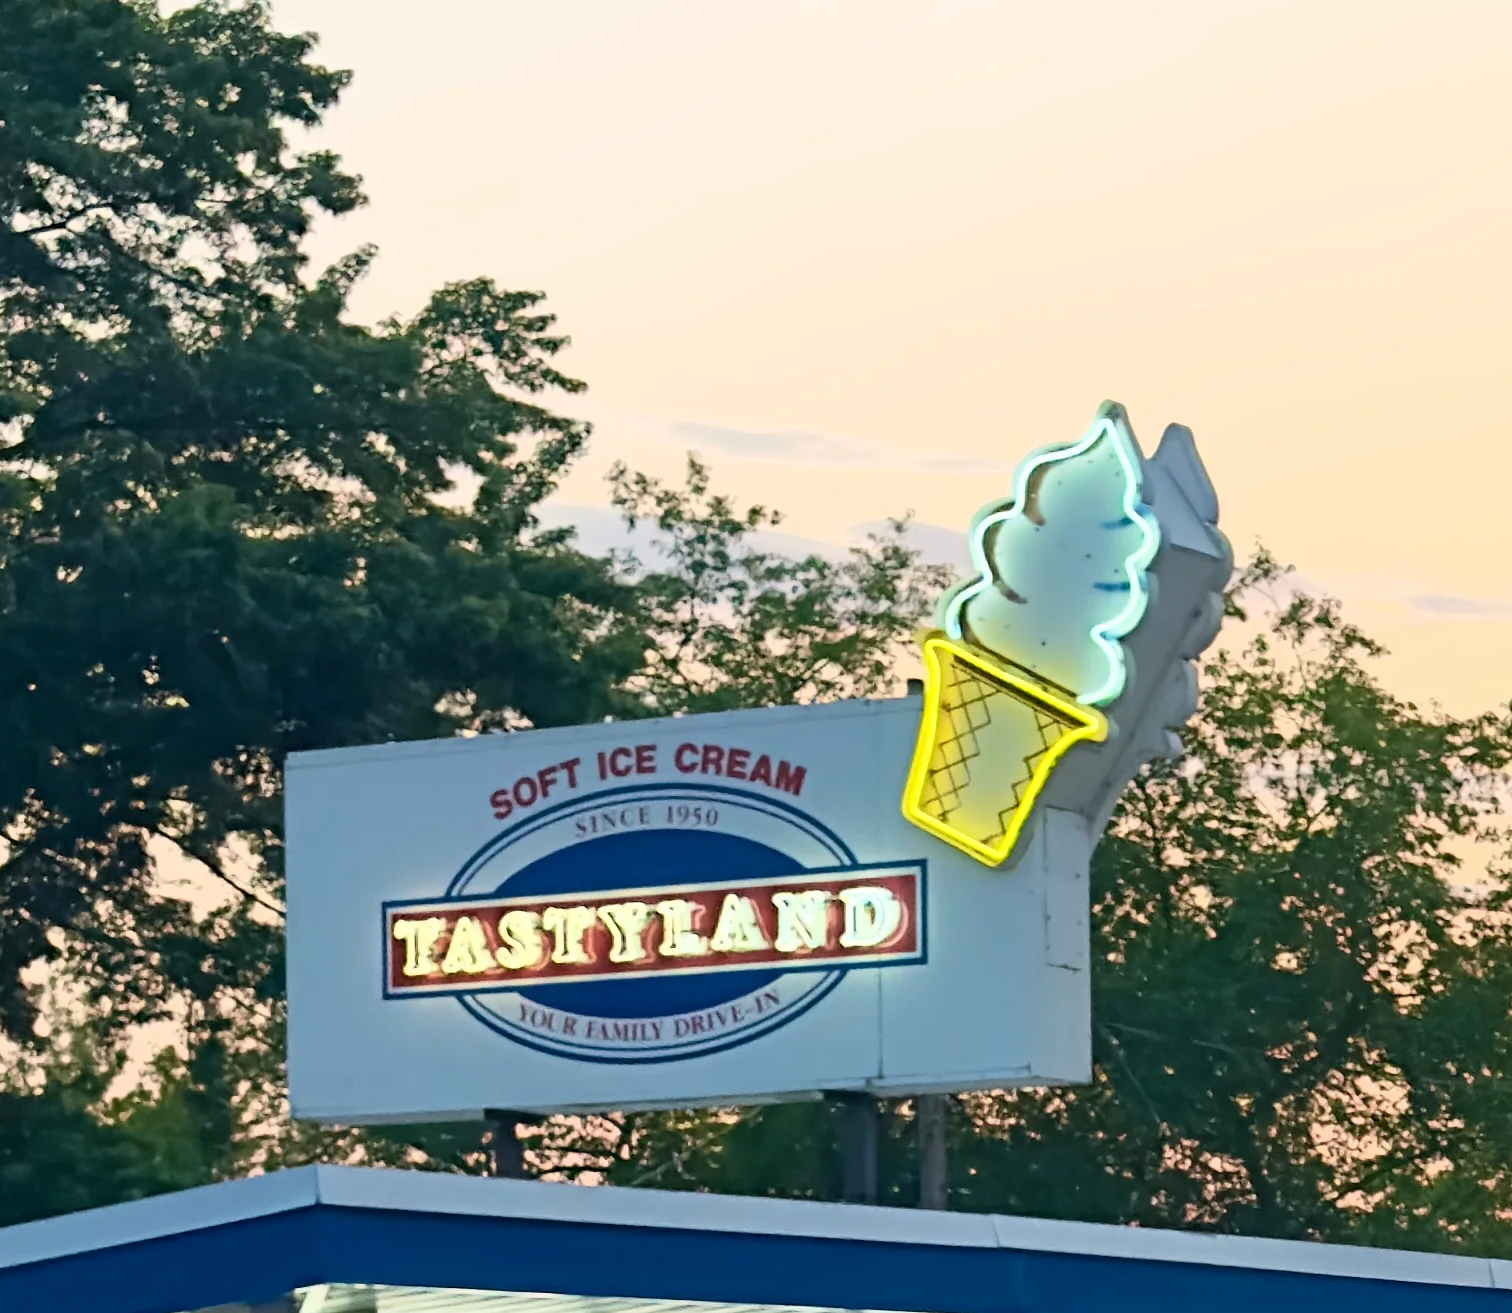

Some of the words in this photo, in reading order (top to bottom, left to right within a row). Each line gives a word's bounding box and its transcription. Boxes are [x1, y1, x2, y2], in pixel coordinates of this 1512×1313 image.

[490, 757, 581, 820] SOFT
[598, 744, 658, 779] ICE
[674, 743, 807, 797] CREAM
[575, 805, 651, 838] SINCE
[667, 805, 720, 827] 1950
[392, 886, 904, 980] TASTYLAND
[518, 1003, 579, 1038] YOUR
[586, 1020, 665, 1044] FAMILY
[673, 988, 780, 1039] DRIVE-IN
